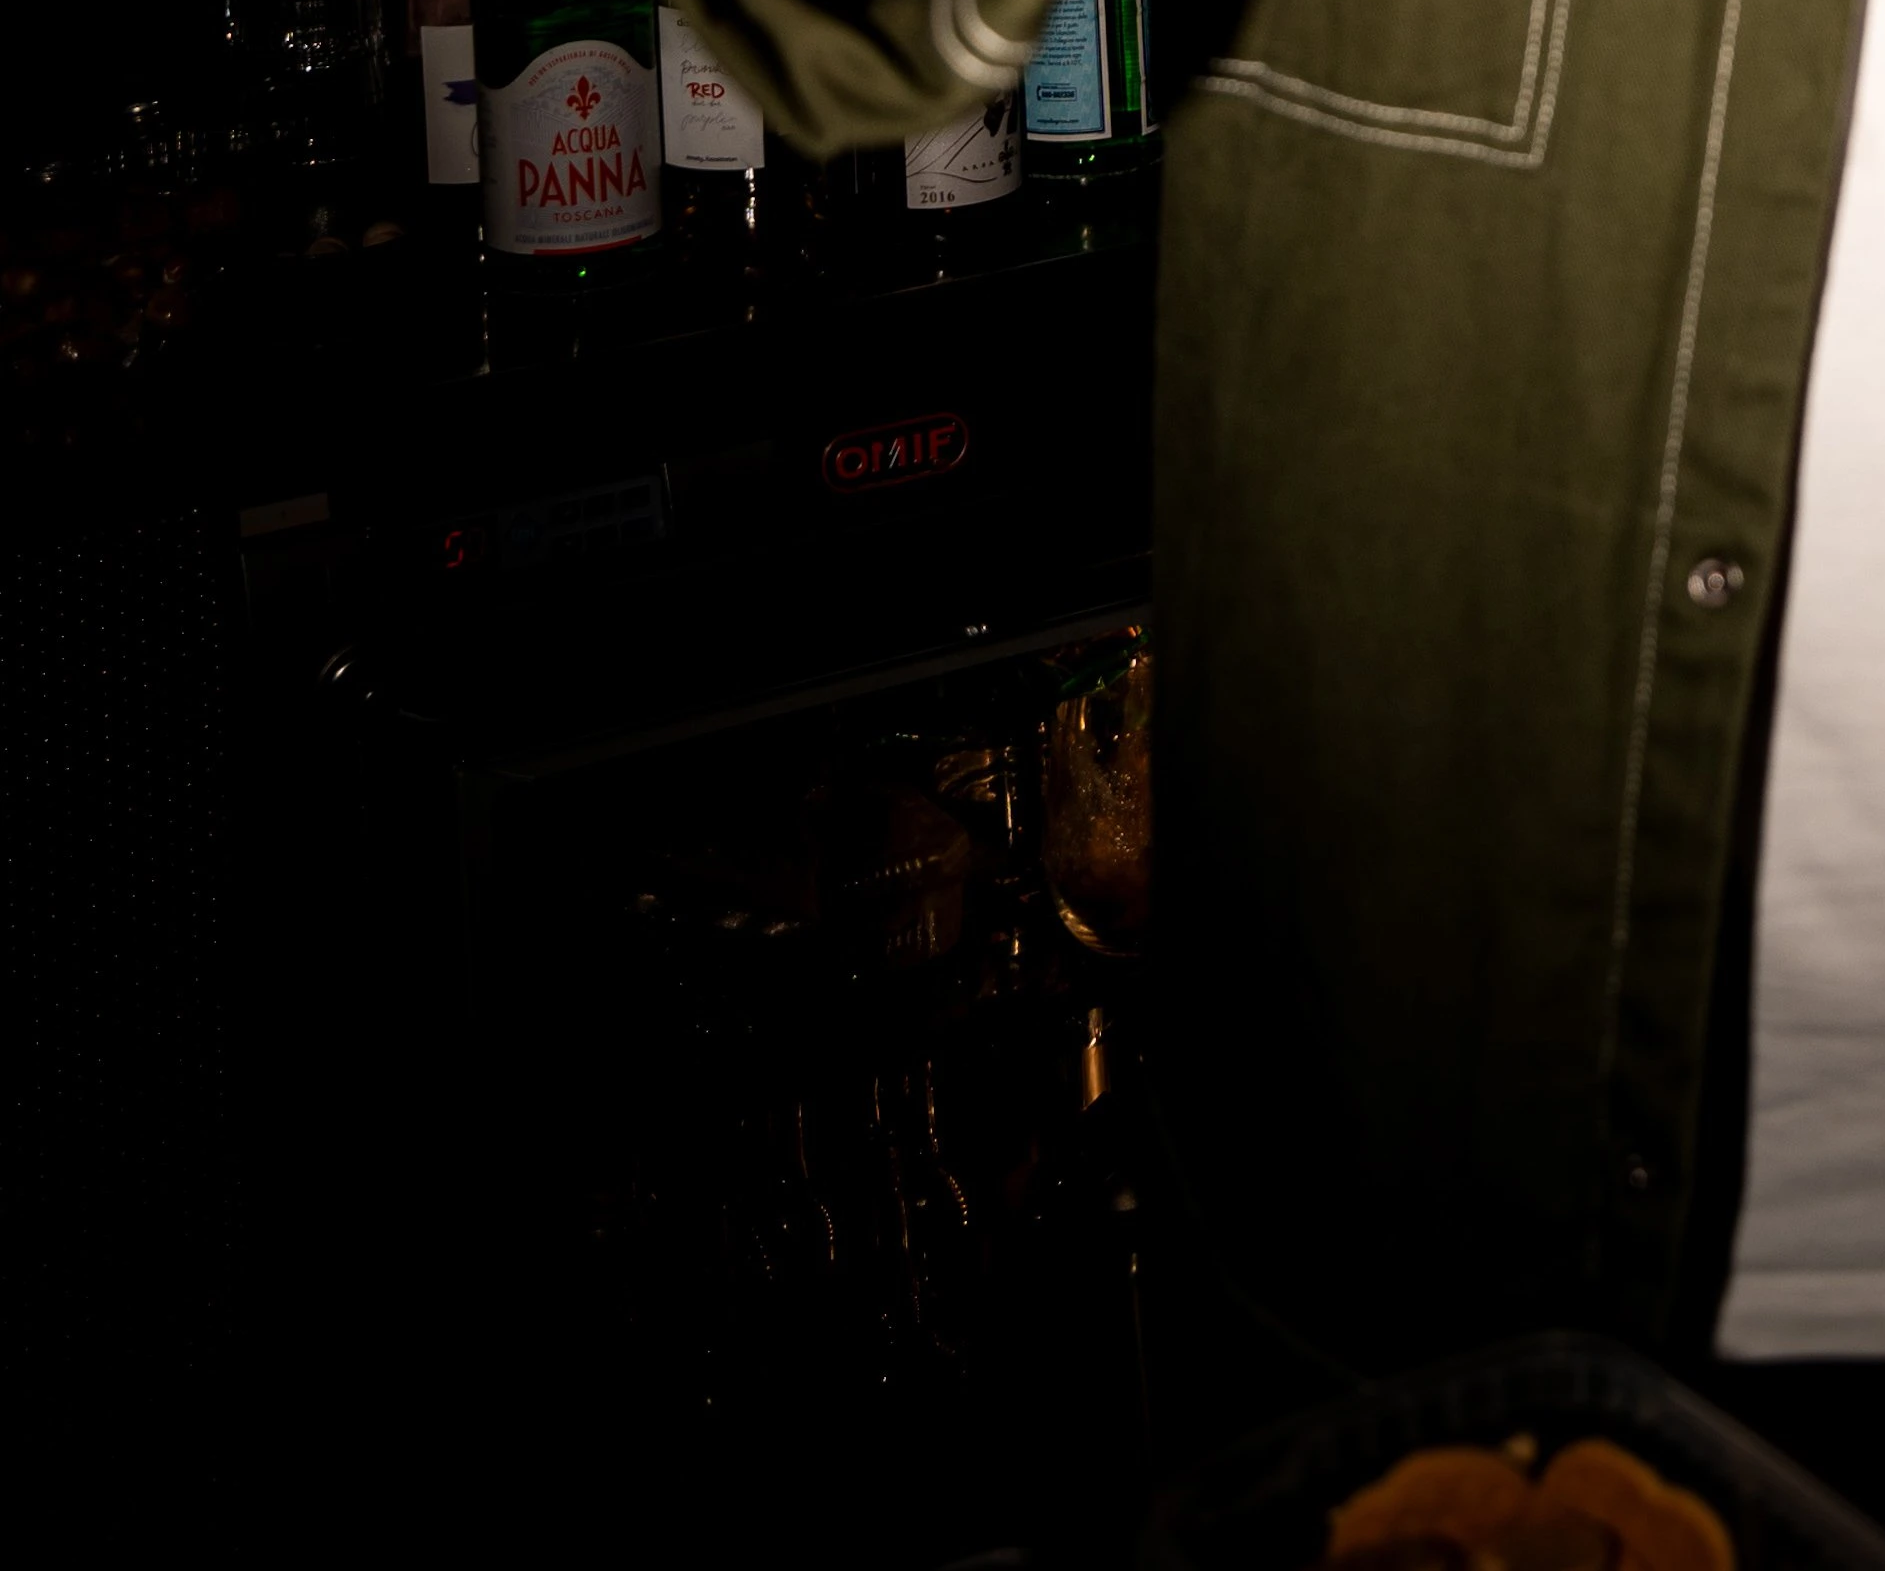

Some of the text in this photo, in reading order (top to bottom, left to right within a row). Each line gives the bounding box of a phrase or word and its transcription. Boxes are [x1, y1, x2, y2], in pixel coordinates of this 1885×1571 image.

[686, 82, 725, 99] RED
[552, 124, 621, 155] ACQUA
[518, 150, 647, 208] PANNA
[920, 191, 956, 204] 2016
[552, 206, 624, 223] TOSCANA
